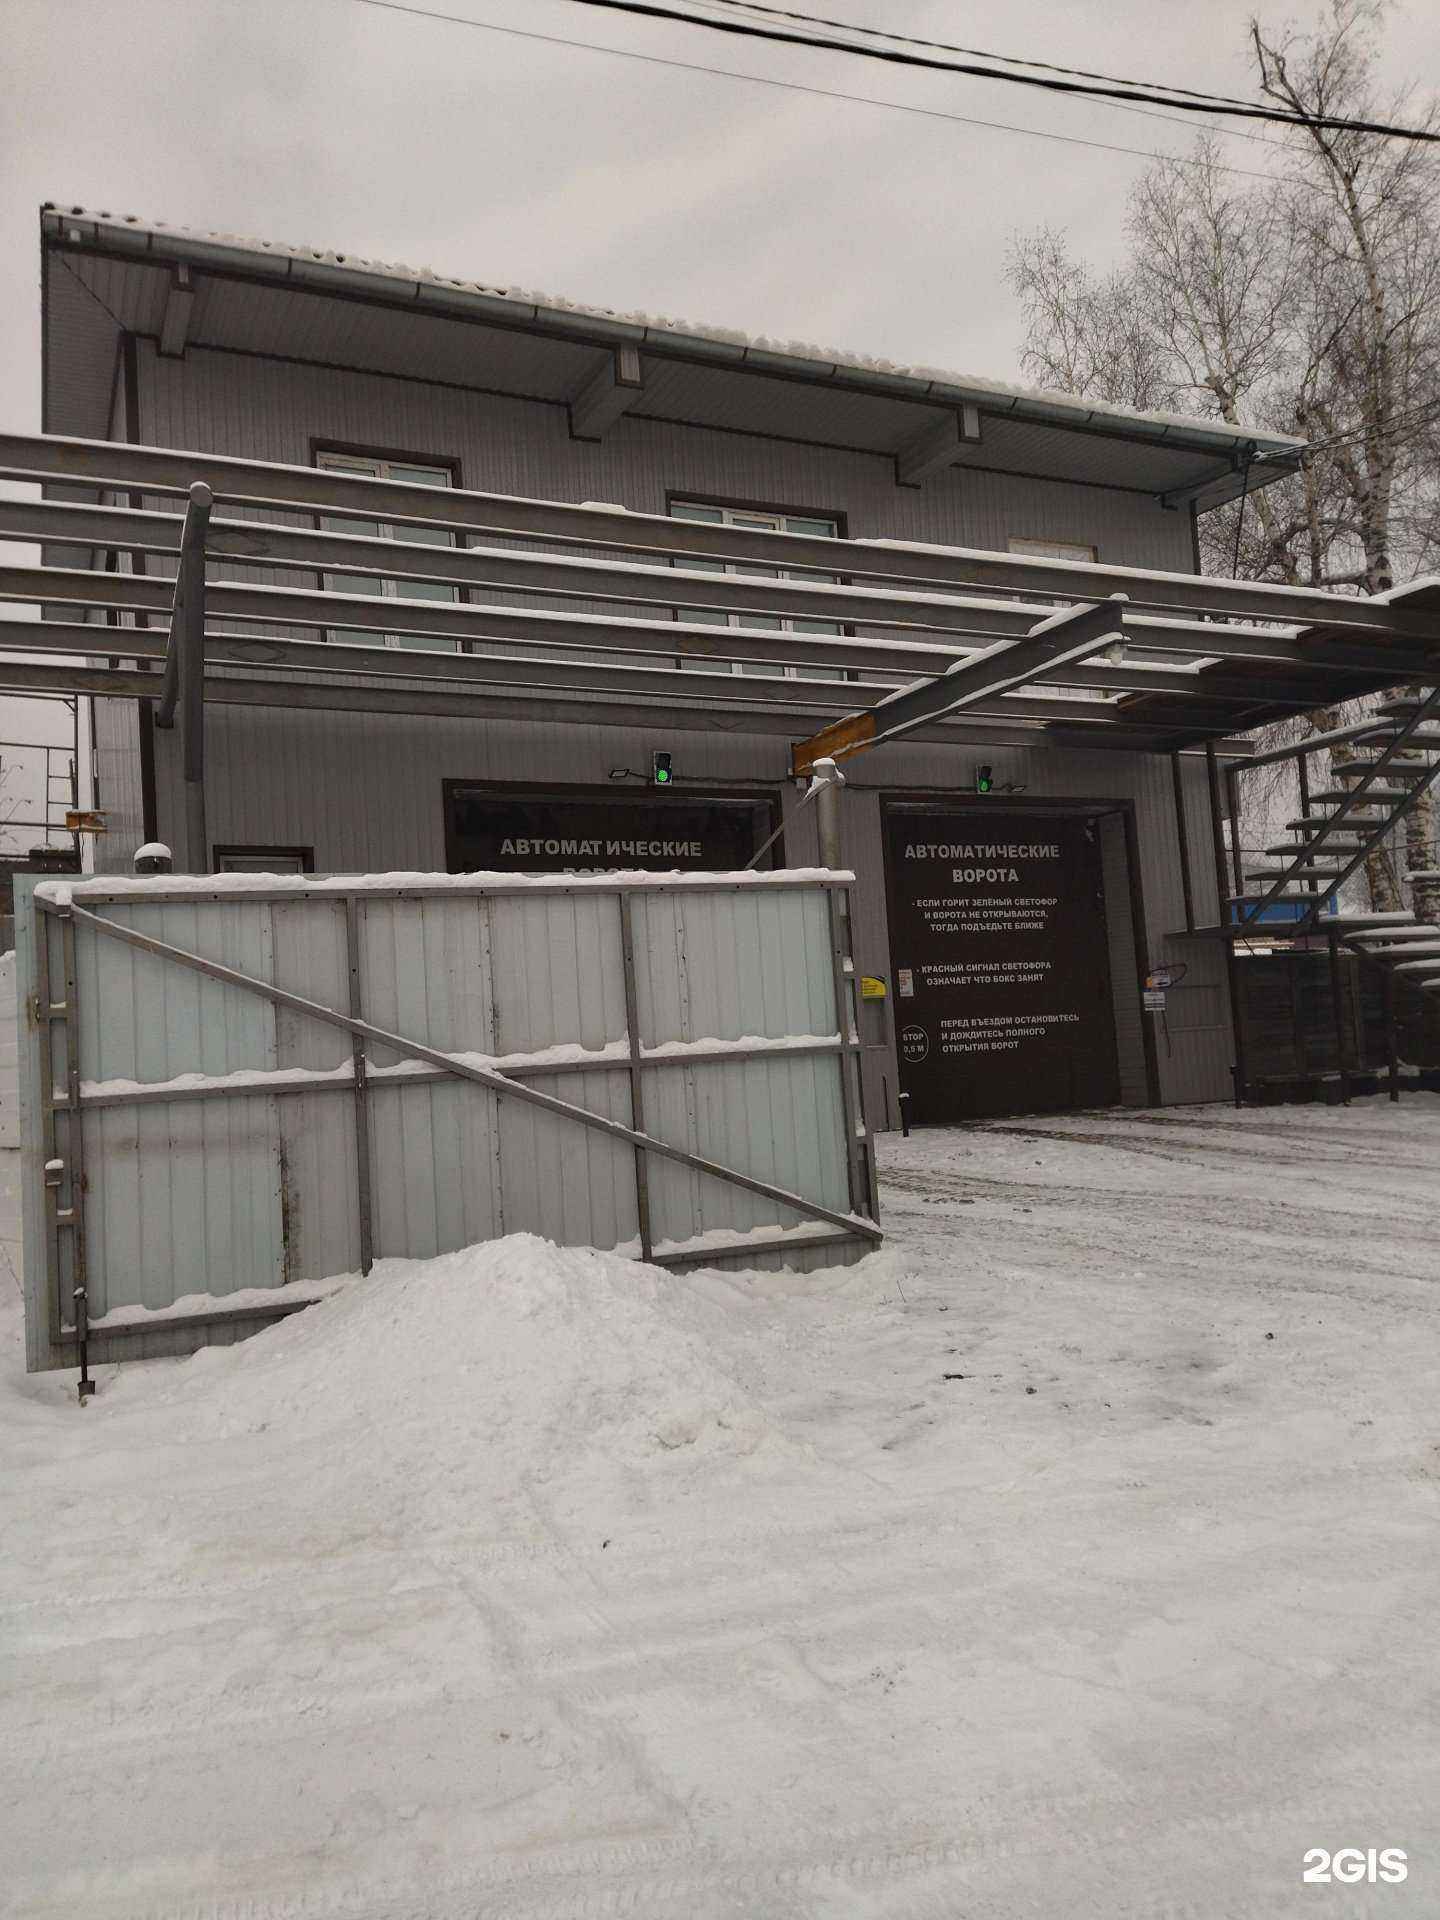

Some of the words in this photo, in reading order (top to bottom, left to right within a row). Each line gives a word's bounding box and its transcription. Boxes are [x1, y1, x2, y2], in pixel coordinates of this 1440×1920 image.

[904, 844, 1060, 858] АВТОМАТИЧЕСКИЕ
[952, 868, 1020, 883] ВОРОТА
[942, 899, 970, 907] ГОРИТ
[1014, 898, 1058, 906] СВЕТОФОР
[924, 911, 931, 919] И
[933, 911, 967, 919] ВОРОТА
[969, 911, 981, 919] НЕ
[930, 923, 959, 932] ТОГДА
[961, 923, 1013, 932] ПОДЪЕДЬТЕ
[1015, 922, 1044, 930] БЛИЖЕ
[922, 964, 964, 974] КРАСНЫЙ
[966, 963, 1000, 972] СИГНАЛ
[1002, 962, 1052, 971] СВЕТОФОРА
[926, 977, 971, 986] ОЗНАЧАЕТ
[973, 975, 991, 984] ЧТО
[993, 975, 1015, 983] БОКС
[1017, 974, 1044, 983] ЗАНЯТ
[941, 1019, 969, 1028] ПЕРЕД
[971, 1017, 1013, 1027] ВЪЕЗДОМ
[1015, 1014, 1080, 1024] ОСТАНОВИТЕСЬ
[941, 1032, 948, 1041] И
[950, 1030, 1004, 1041] ДОЖДИТЕСЬ
[1005, 1027, 1046, 1037] ПОЛНОГО
[942, 1043, 990, 1053] ОТКРЫТИЯ
[991, 1041, 1020, 1051] ВОРОТ
